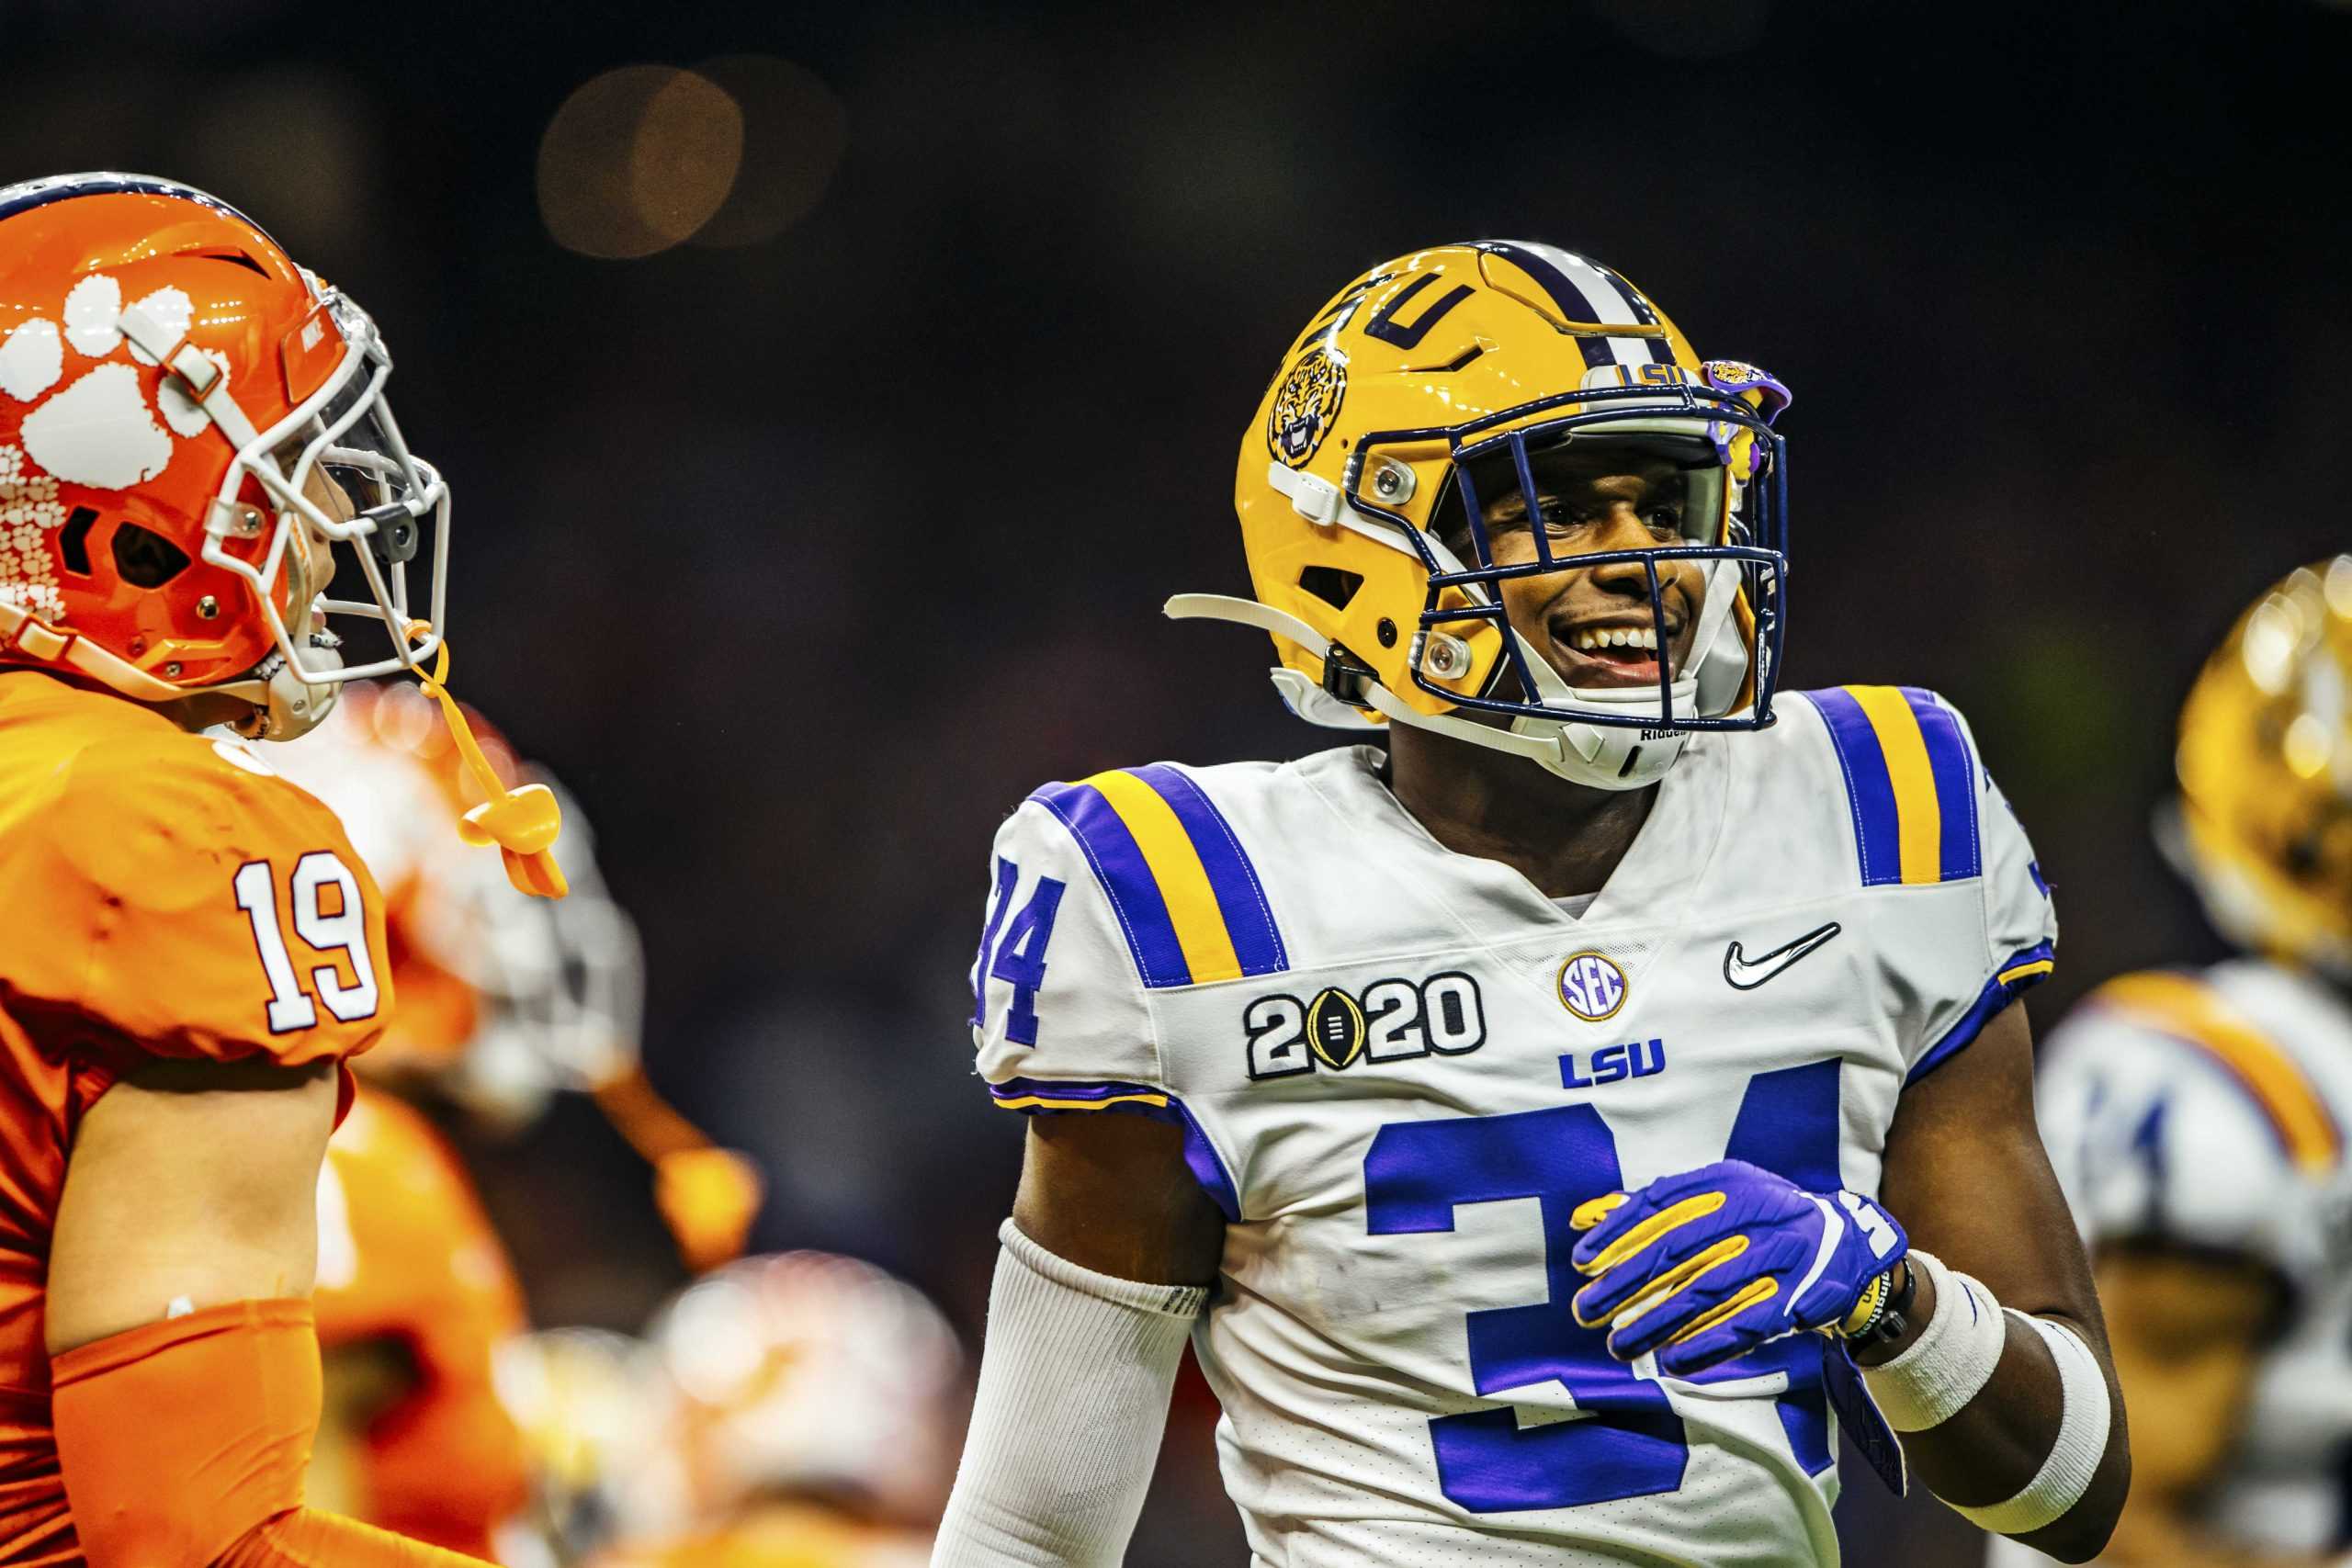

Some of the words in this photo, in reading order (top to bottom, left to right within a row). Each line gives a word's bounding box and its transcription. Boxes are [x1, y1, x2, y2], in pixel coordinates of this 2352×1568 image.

[232, 850, 379, 1035] 19
[1563, 957, 1624, 1016] SEC
[1558, 1038, 1666, 1089] LSU
[1363, 1056, 1844, 1514] 34
